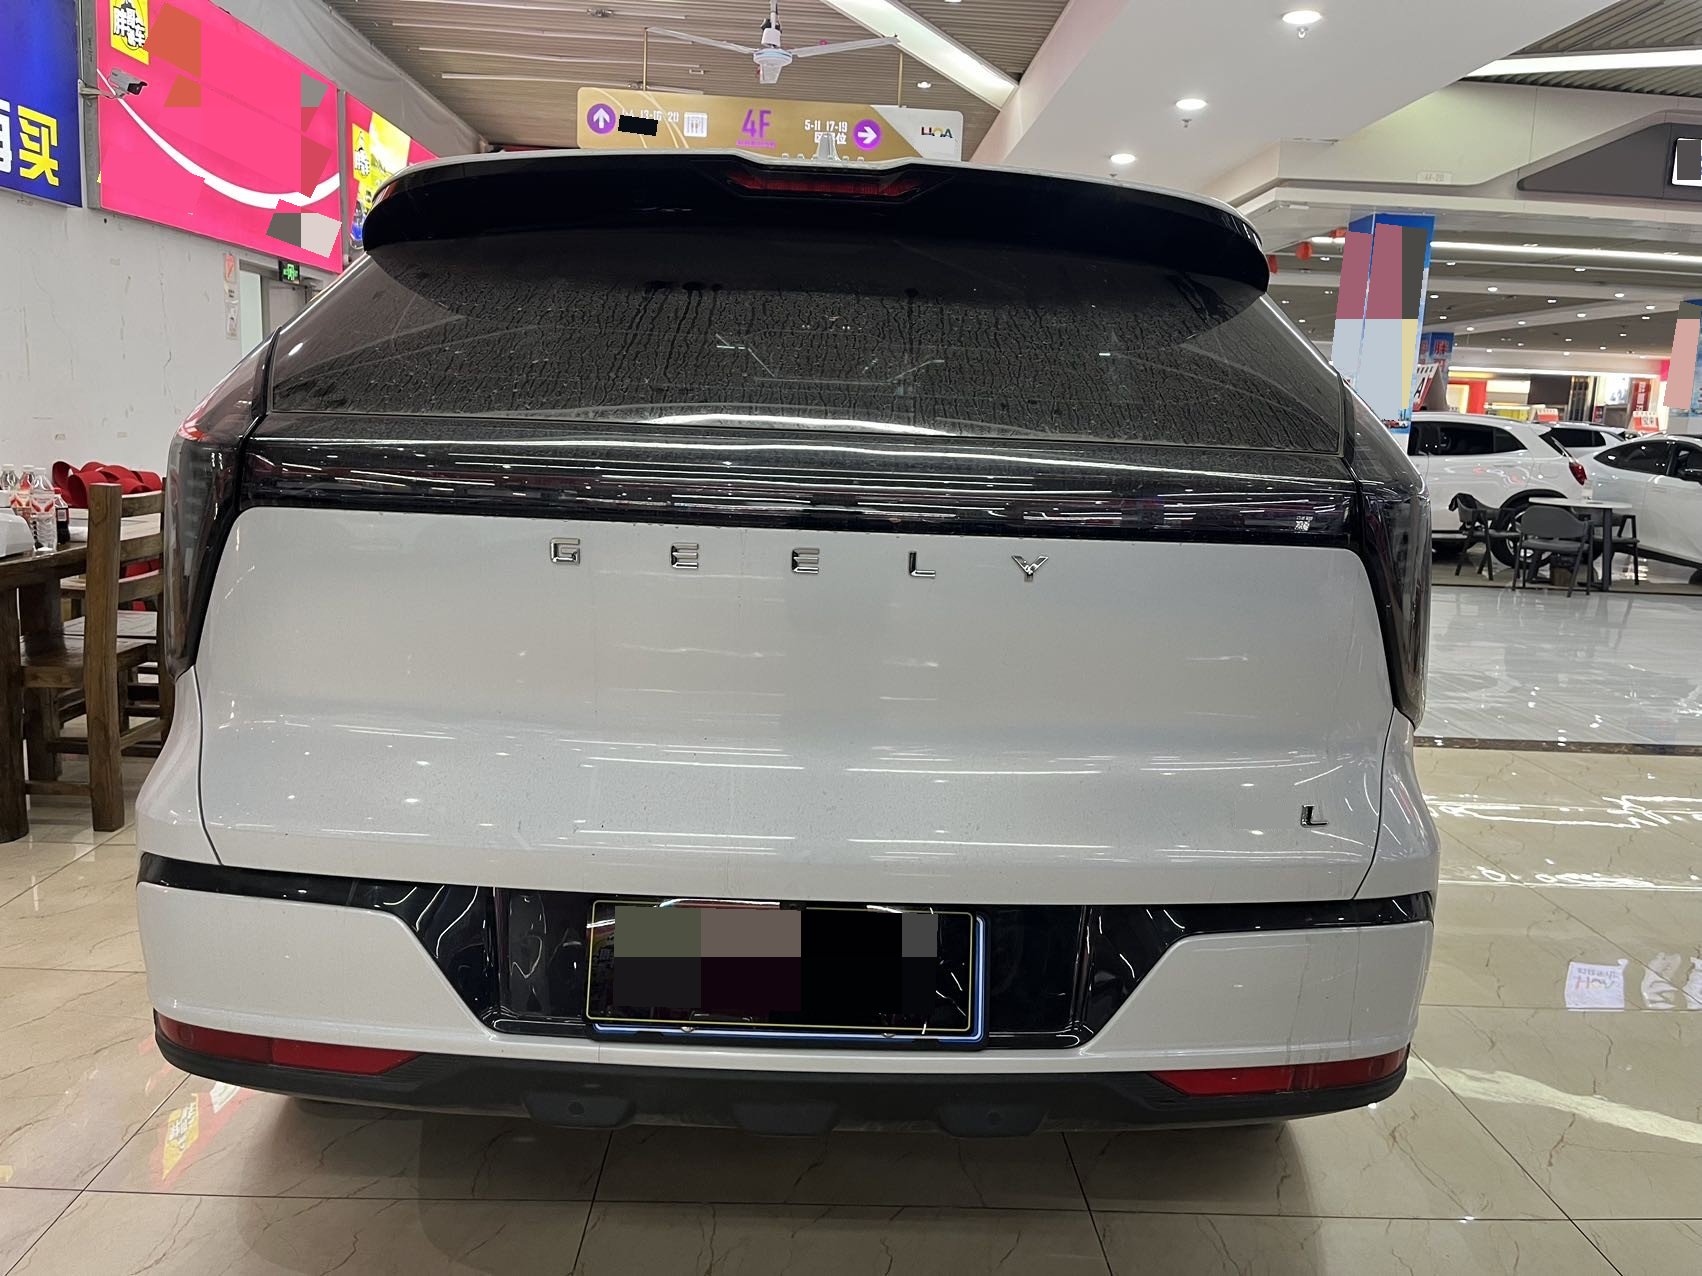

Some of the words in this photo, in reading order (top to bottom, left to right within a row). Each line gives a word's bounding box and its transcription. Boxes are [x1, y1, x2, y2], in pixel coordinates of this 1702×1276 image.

[667, 111, 679, 122] 20
[741, 108, 772, 138] 4F
[804, 119, 821, 131] 5-11
[826, 121, 848, 133] 17-19
[814, 132, 847, 145] 区位
[550, 537, 1049, 583] GEELY
[1300, 804, 1329, 828] L
